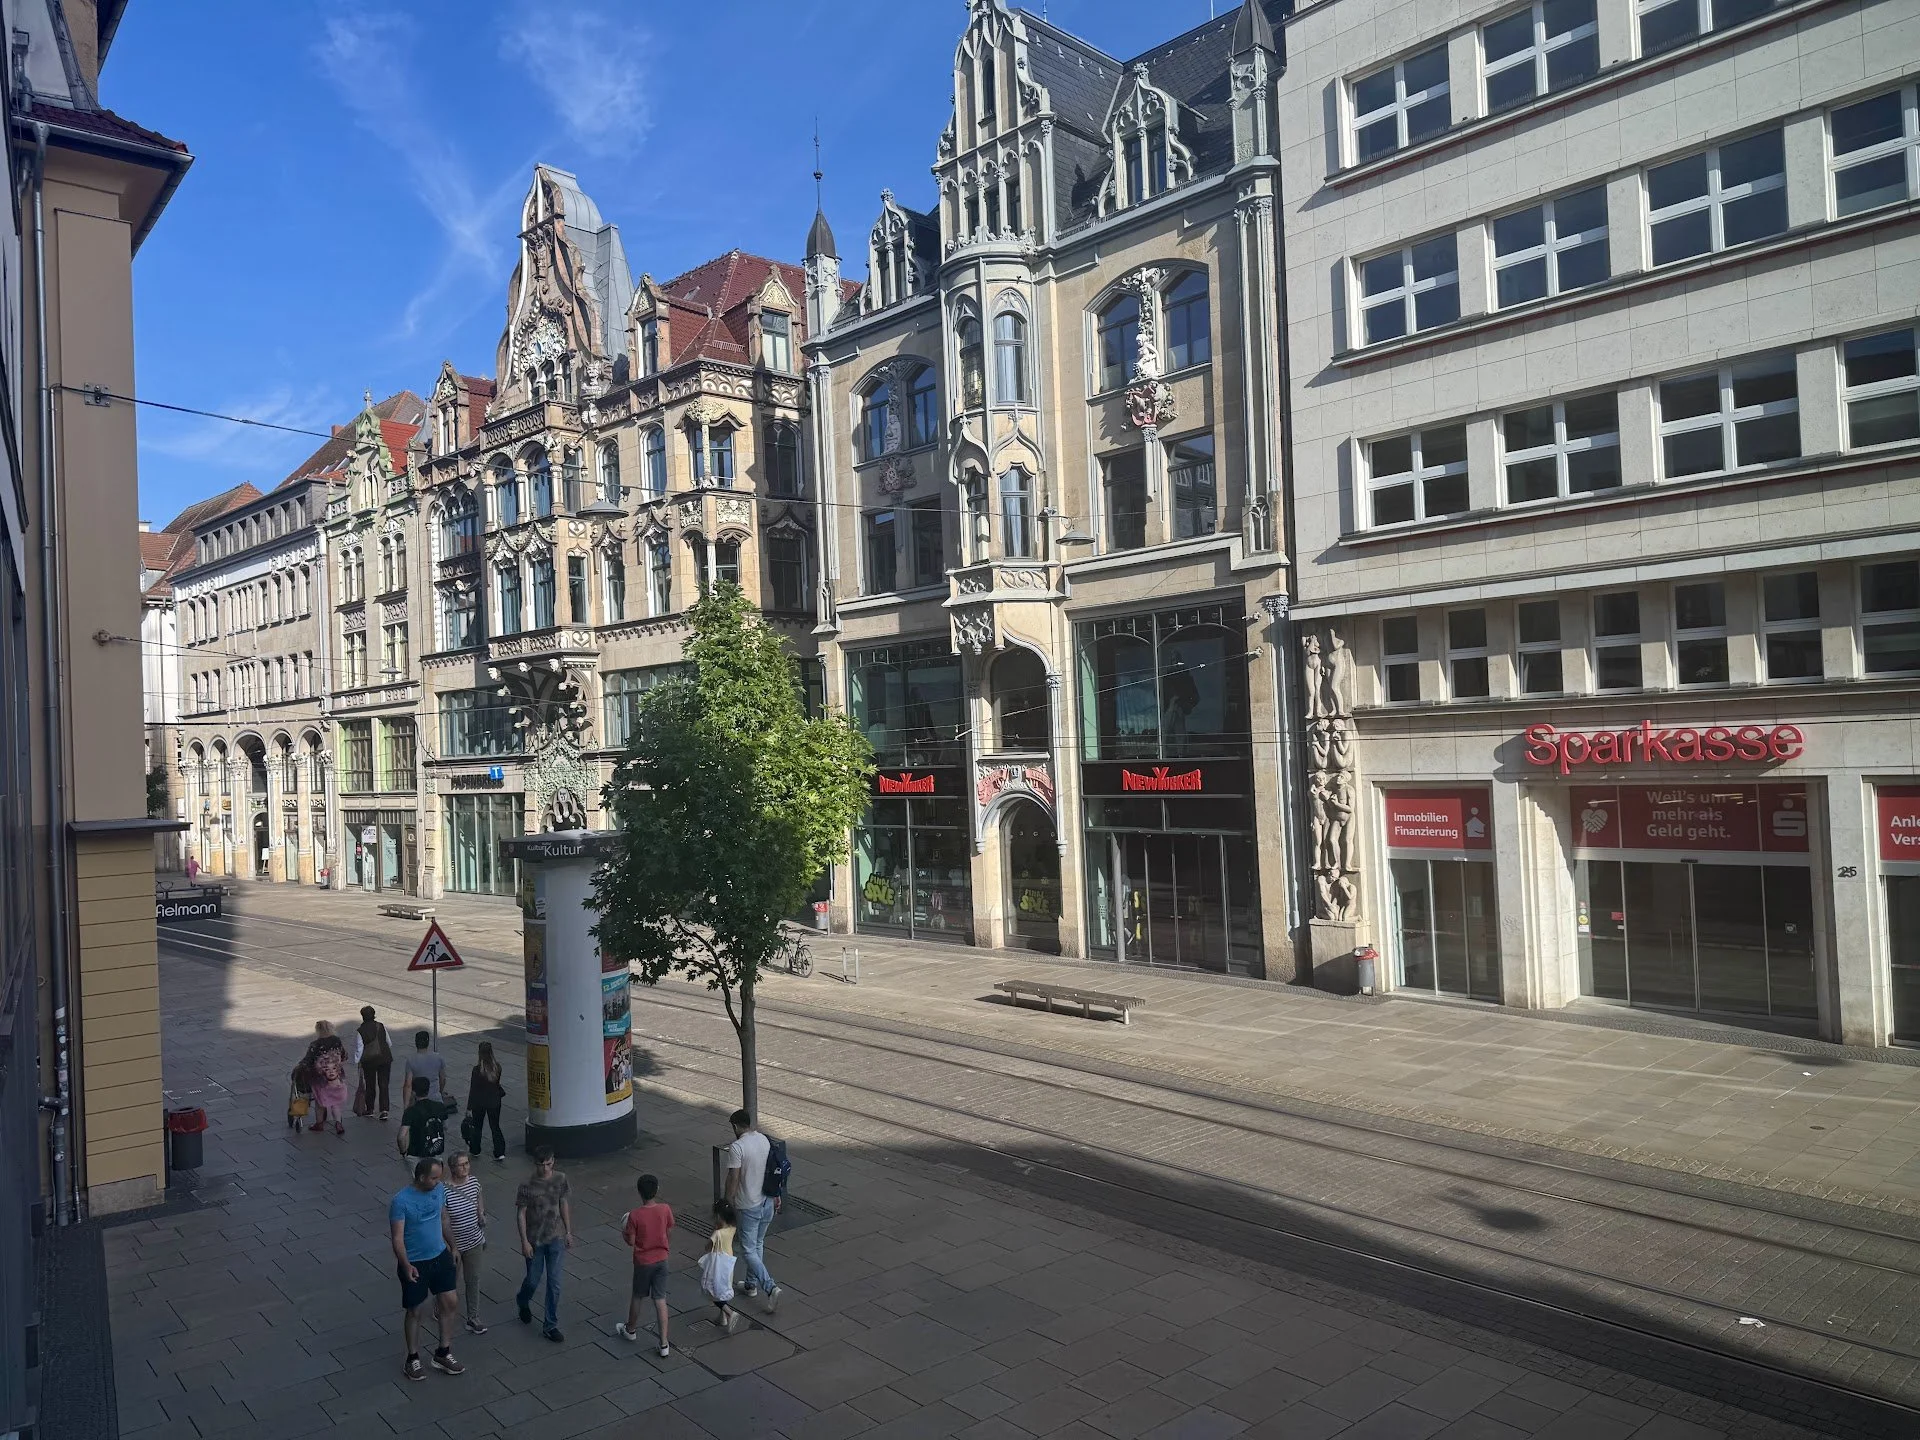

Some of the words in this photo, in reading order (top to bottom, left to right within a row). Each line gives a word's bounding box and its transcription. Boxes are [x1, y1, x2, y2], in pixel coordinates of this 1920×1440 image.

[1524, 719, 1805, 775] Sparkasse
[1700, 793, 1727, 804] um
[1394, 812, 1448, 823] Immobilien
[1652, 807, 1694, 820] mehr
[1699, 807, 1723, 820] als
[1394, 826, 1458, 839] Finanzierung
[1646, 824, 1683, 837] Geld
[1687, 824, 1731, 841] geht.
[544, 844, 582, 857] Kultur
[1838, 866, 1857, 878] 25
[864, 882, 895, 905] SALE
[156, 903, 217, 917] fielmann
